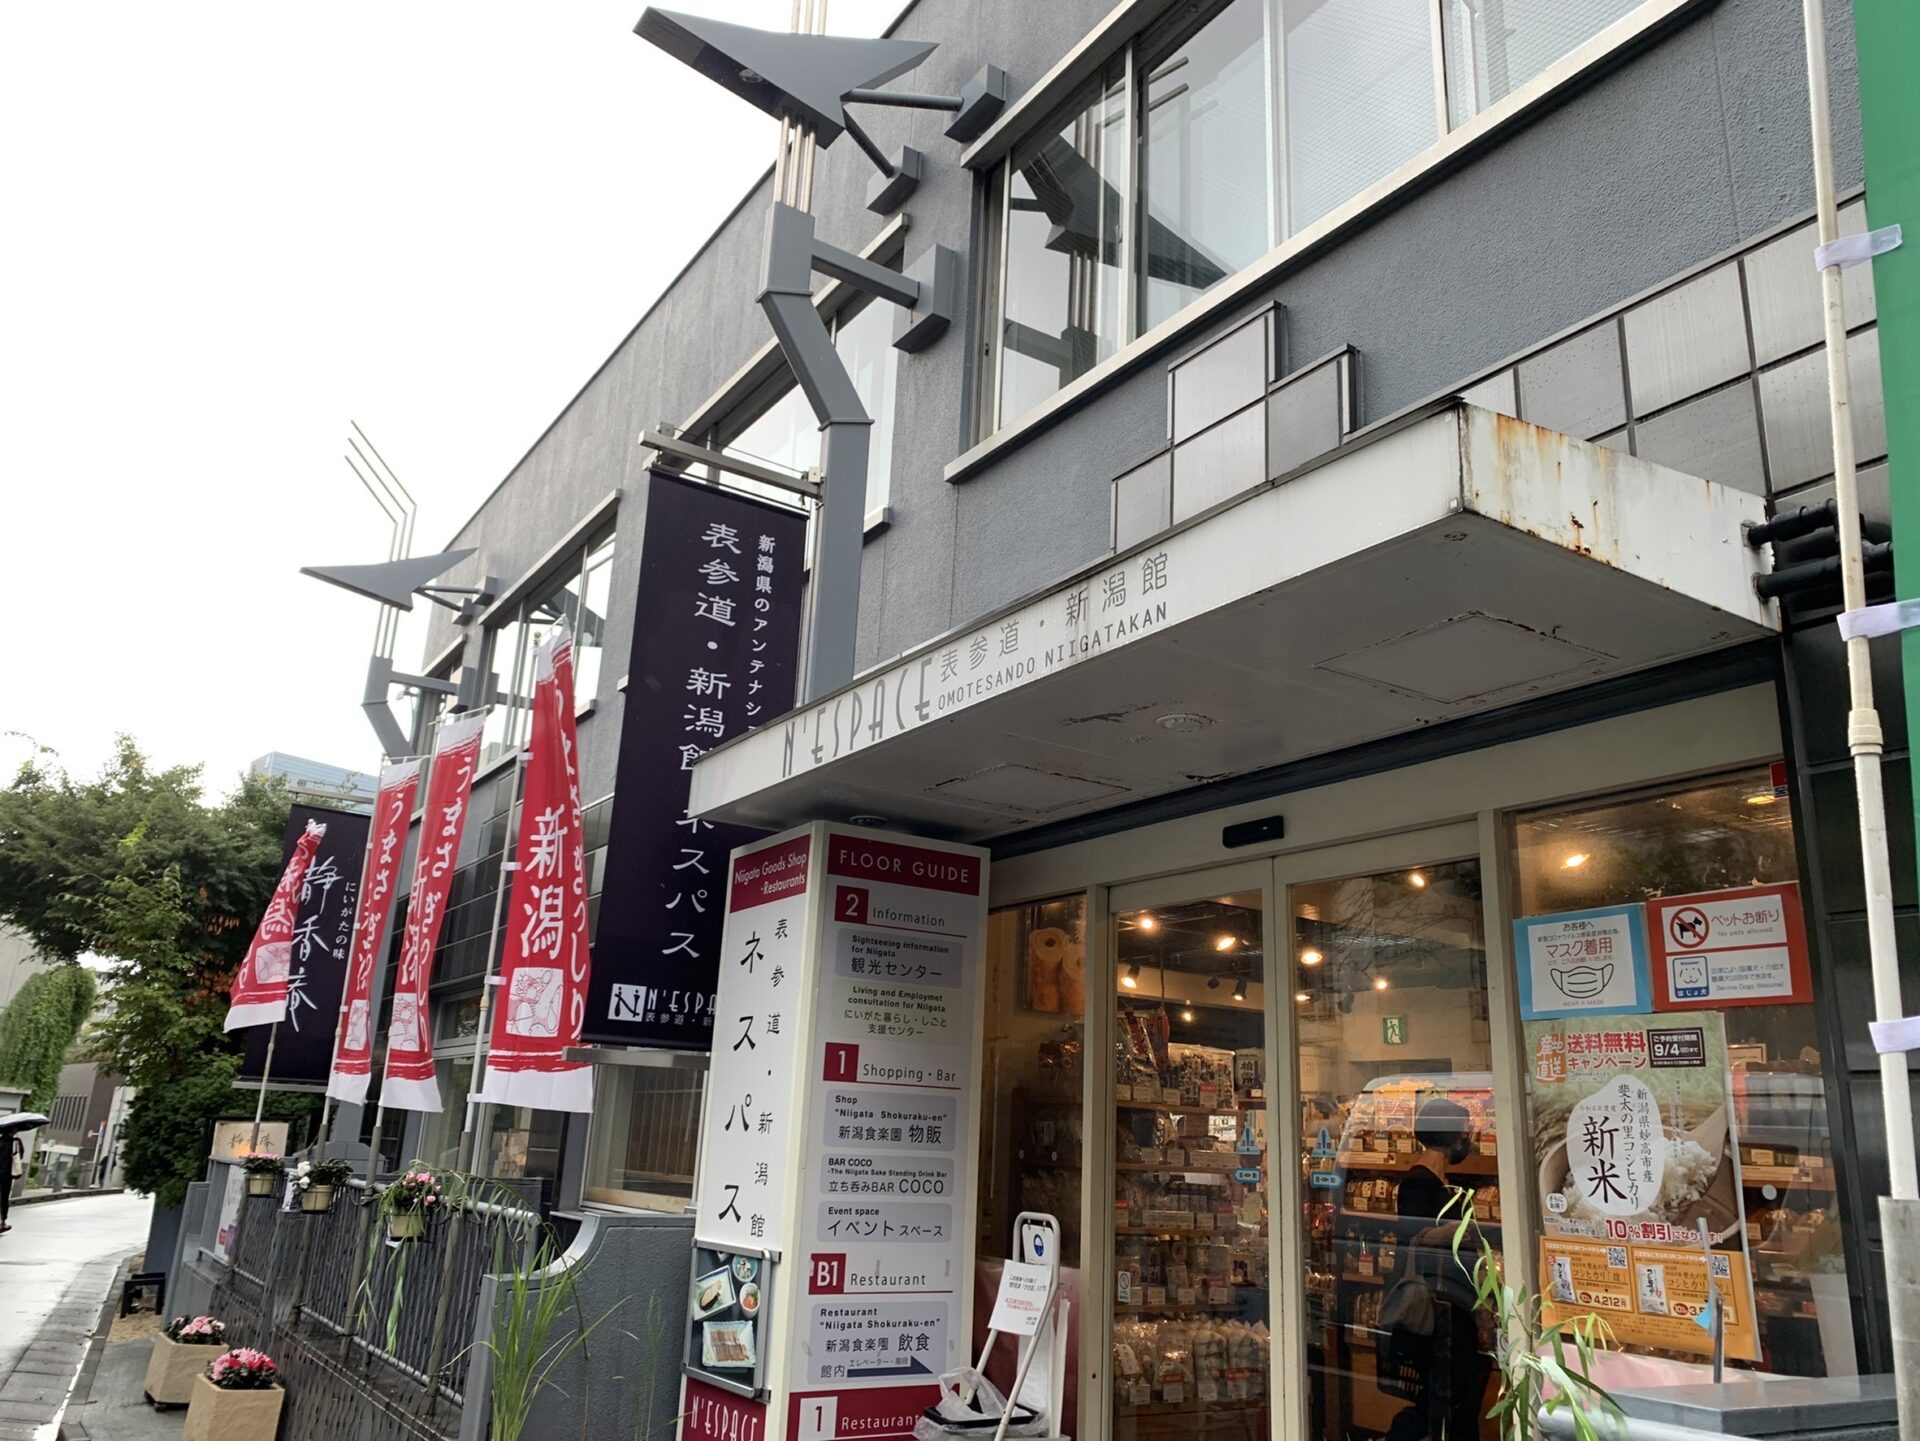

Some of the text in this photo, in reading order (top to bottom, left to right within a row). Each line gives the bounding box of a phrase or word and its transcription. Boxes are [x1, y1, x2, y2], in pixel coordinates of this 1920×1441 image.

[940, 552, 1168, 682] 表参道・新潟館
[745, 534, 775, 731] 新潟県のアンテナシ
[938, 601, 1167, 710] OMOTESANDO NIIGATAKAN
[782, 657, 932, 778] N'ESPACE
[734, 852, 807, 885] Niigata Goods Shop
[839, 850, 969, 883] FLOOR GUIDE
[521, 805, 567, 960] 新潟
[332, 881, 356, 960] にいがたの味
[845, 894, 945, 927] 2 Information
[1711, 909, 1780, 927] ペットお断り
[852, 935, 901, 949] Sightseeing
[866, 947, 896, 957] Niigata
[1546, 936, 1613, 958] マスク着用
[851, 957, 942, 979] 観光センター
[648, 988, 717, 1015] N'ESPA
[852, 986, 878, 996] Living
[848, 997, 946, 1013] consultation for Niigata
[645, 1011, 713, 1027] 表参道・新
[844, 1009, 948, 1028] にいがた暮らし・しごと
[867, 1023, 925, 1037] 支援センター
[1567, 1031, 1647, 1055] 送料無料
[838, 1051, 846, 1075] 1
[863, 1064, 923, 1083] Shopping
[936, 1068, 956, 1082] Bar
[1568, 1056, 1647, 1071] キャンペーン
[718, 931, 764, 1223] ネスパス
[751, 919, 789, 1239] 表参道・新潟館
[835, 1095, 858, 1105] Shop
[838, 1125, 942, 1144] 新潟食楽園 物販
[1637, 1088, 1654, 1183] 新潟県妙高市産
[1618, 1084, 1640, 1210] 斐太の里コシヒカリ
[828, 1158, 873, 1167] BAR COCO
[1582, 1115, 1628, 1204] 新米
[888, 1170, 917, 1178] Standing
[918, 1170, 935, 1178] Drink
[899, 1179, 944, 1194] COCO
[828, 1207, 880, 1216] Event space
[828, 1220, 894, 1237] イベント
[1606, 1219, 1723, 1243] 10%割引になりす!
[816, 1261, 926, 1287] B1 Restaurant
[820, 1308, 878, 1317] Restaurant
[898, 1332, 930, 1352] 飲食
[820, 1364, 846, 1379] 館内
[815, 1405, 823, 1432] 1
